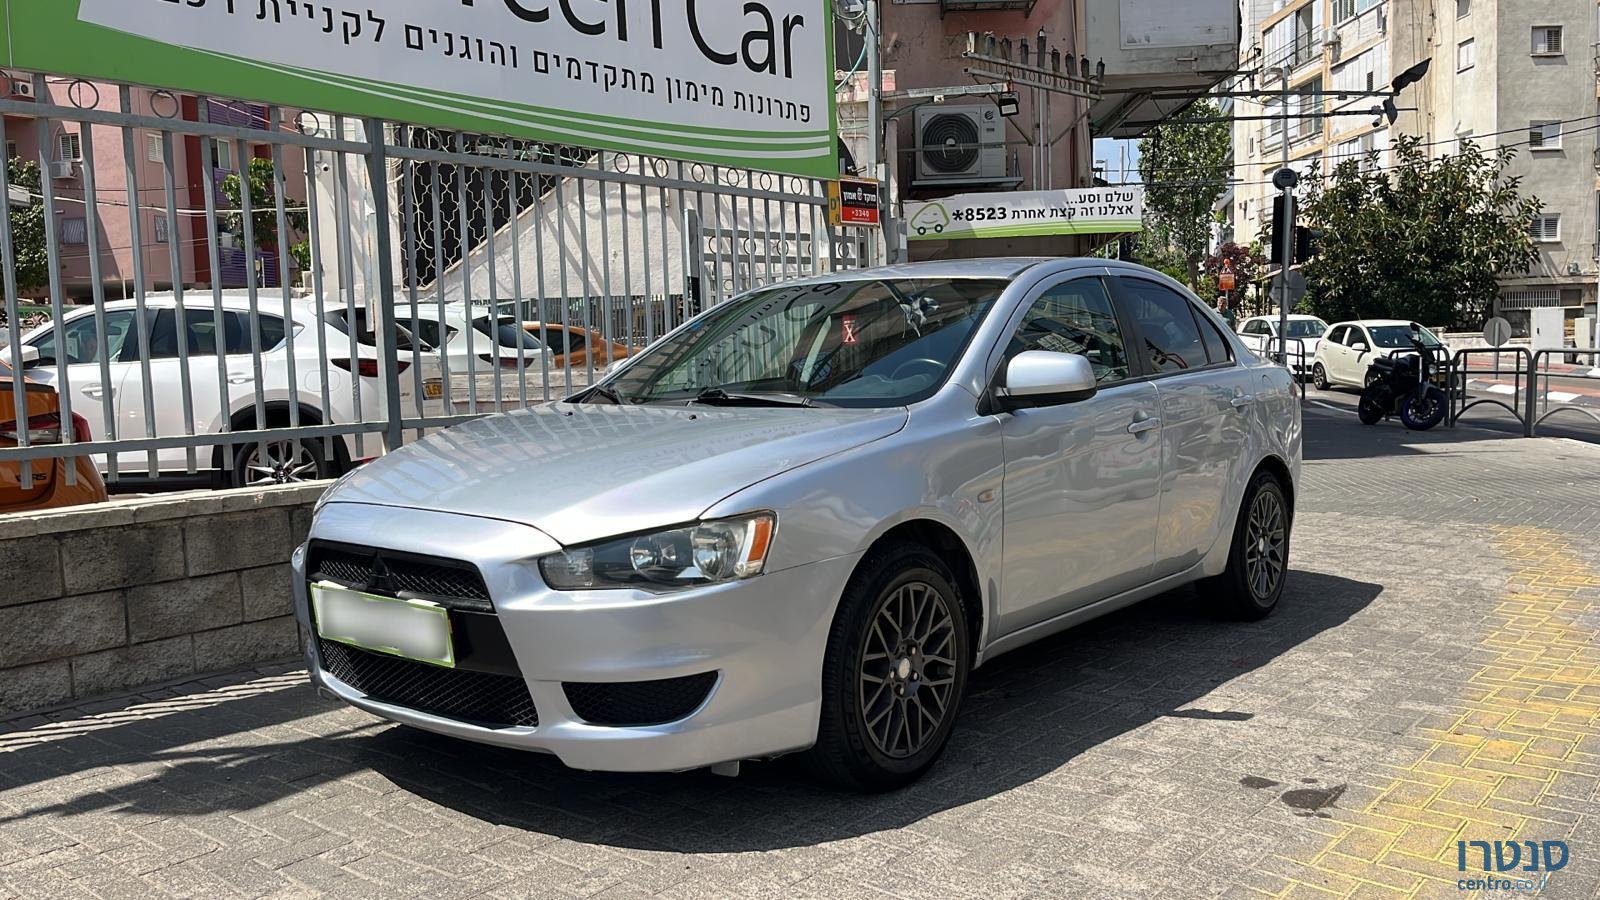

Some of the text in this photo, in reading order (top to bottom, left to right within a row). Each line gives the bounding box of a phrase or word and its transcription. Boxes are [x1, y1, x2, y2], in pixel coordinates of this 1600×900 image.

[256, 0, 386, 45] לקניית
[404, 24, 518, 69] והוגנים
[533, 50, 655, 94] מתקדמים
[666, 77, 724, 107] מימון
[733, 91, 811, 123] פתרונות
[1105, 191, 1134, 203] שלם
[1011, 208, 1046, 220] אחרת
[1050, 207, 1076, 219] קצת
[1080, 207, 1095, 216] זה
[1098, 204, 1134, 216] אצלנו
